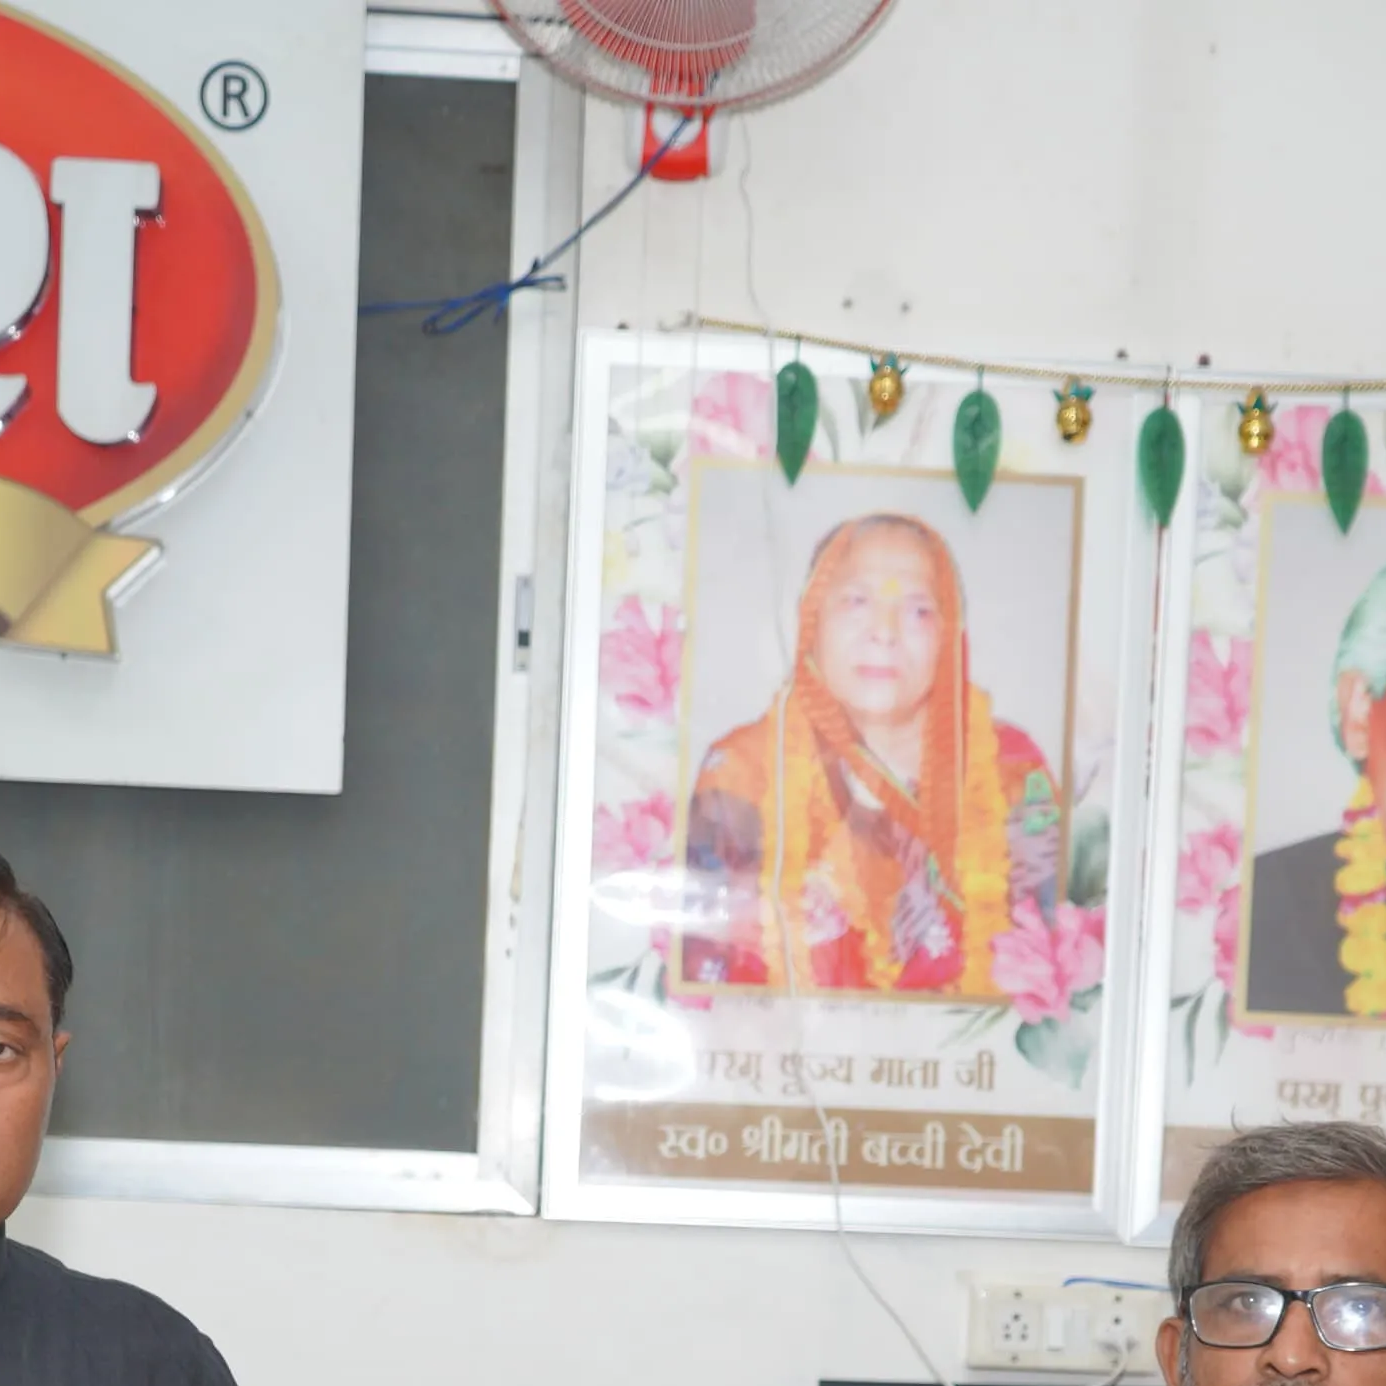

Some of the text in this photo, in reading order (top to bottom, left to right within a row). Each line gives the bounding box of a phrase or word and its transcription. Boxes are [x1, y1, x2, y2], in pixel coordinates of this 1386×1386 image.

[870, 1054, 941, 1089] माता
[956, 1047, 997, 1092] जी
[741, 1113, 849, 1166] श्रीमती
[957, 1120, 1025, 1174] देवी
